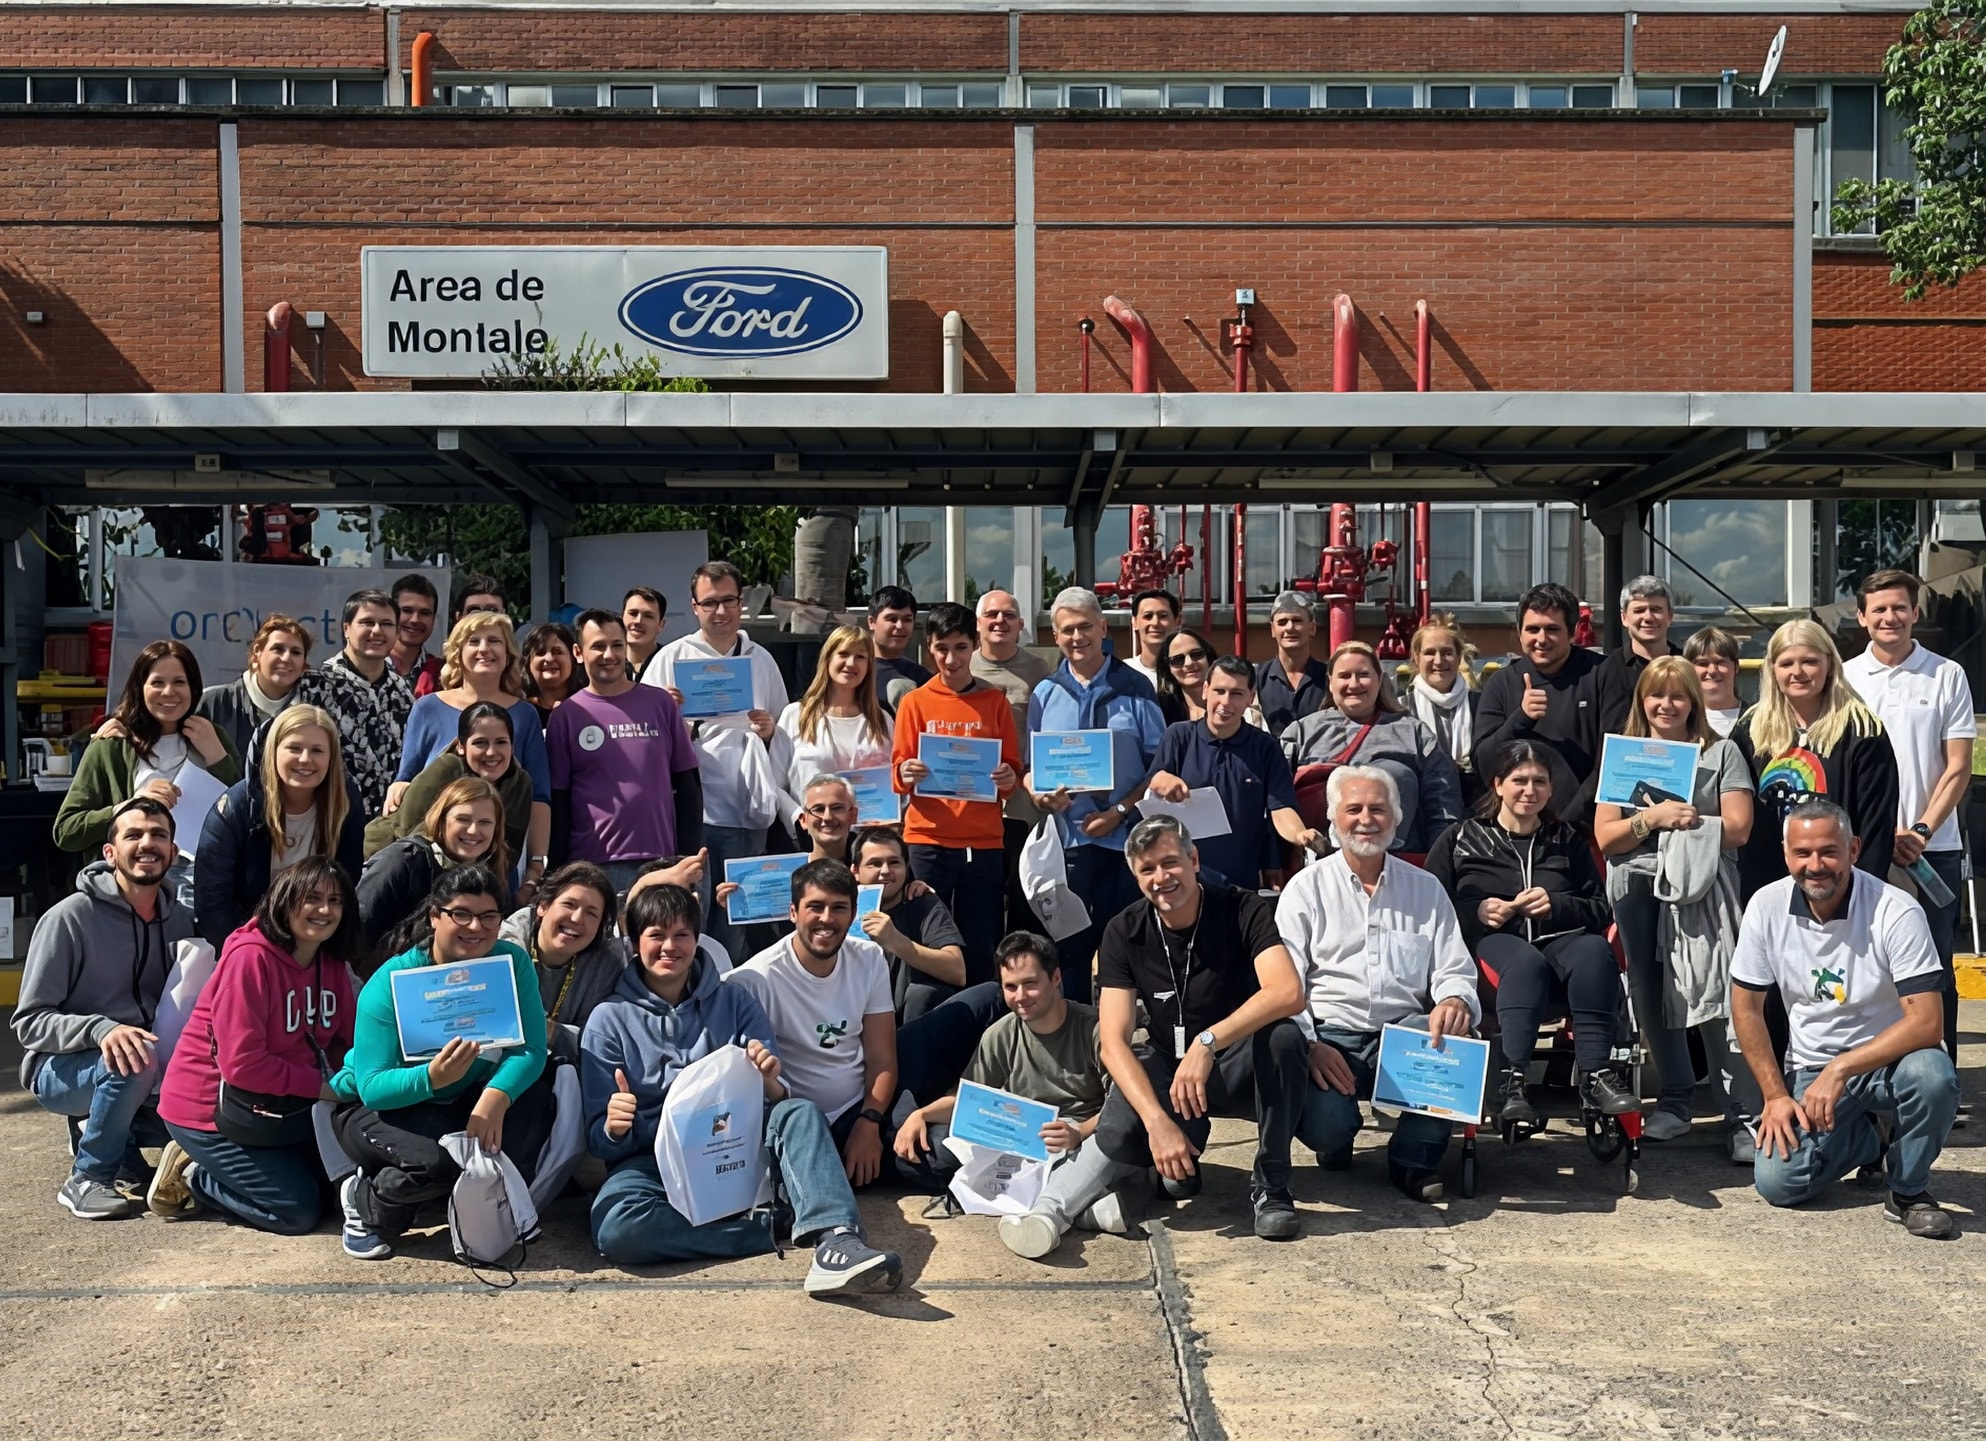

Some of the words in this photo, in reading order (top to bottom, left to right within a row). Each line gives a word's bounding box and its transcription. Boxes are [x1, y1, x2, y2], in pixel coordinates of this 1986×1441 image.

[389, 269, 481, 302] Area
[496, 268, 544, 301] de
[669, 280, 813, 338] Ford
